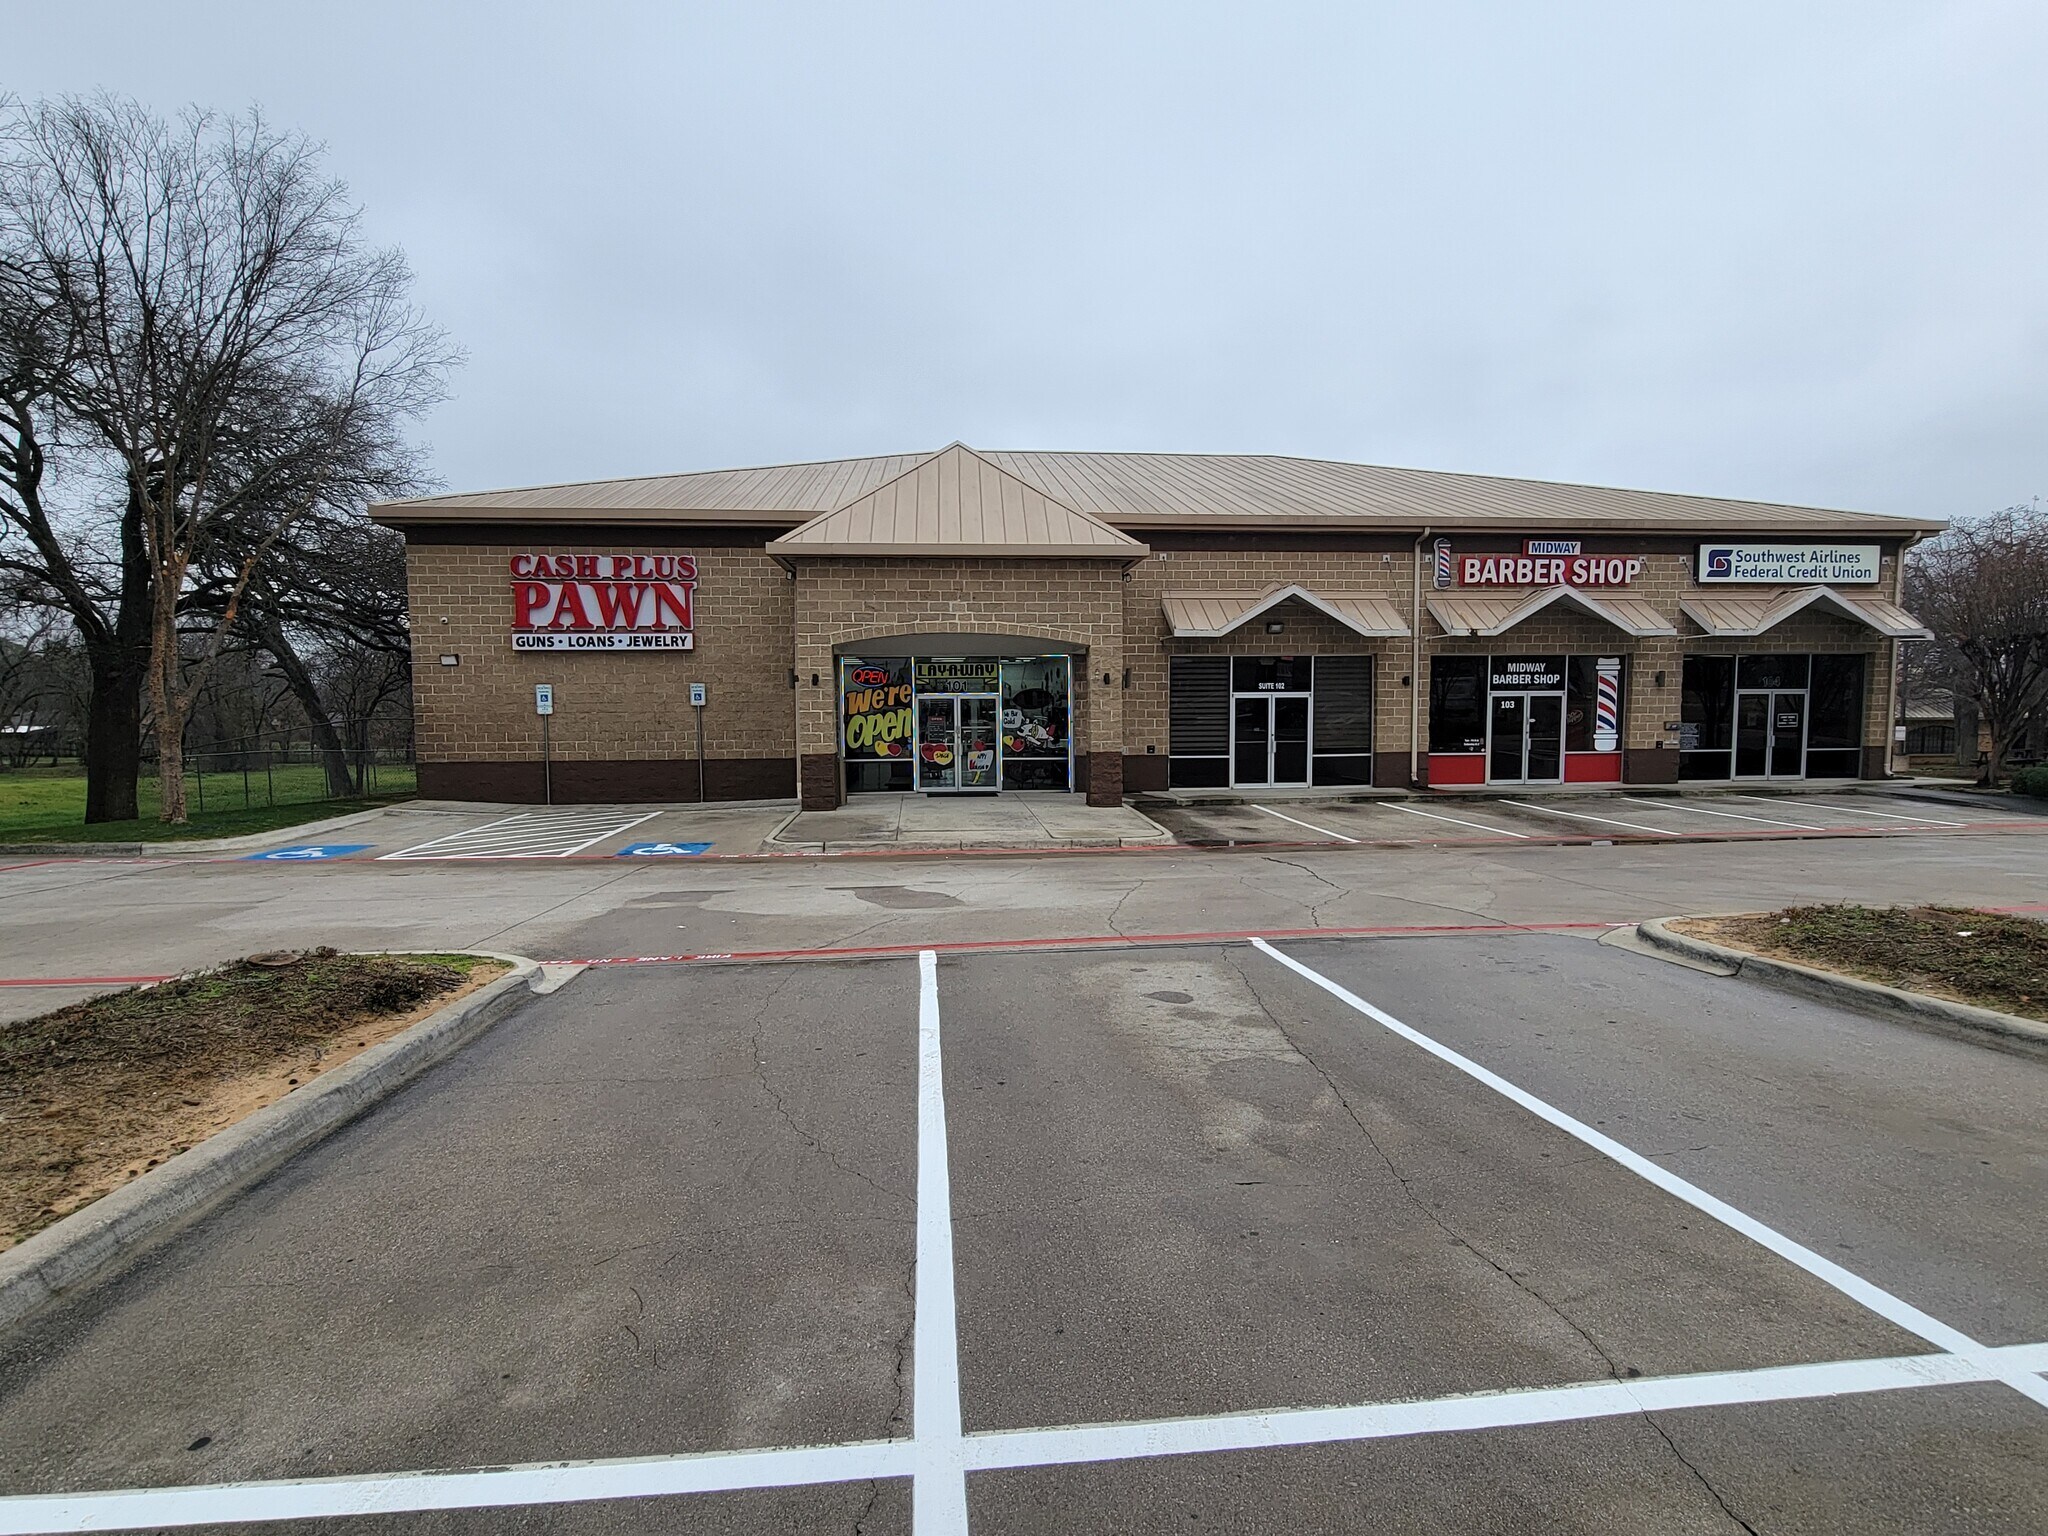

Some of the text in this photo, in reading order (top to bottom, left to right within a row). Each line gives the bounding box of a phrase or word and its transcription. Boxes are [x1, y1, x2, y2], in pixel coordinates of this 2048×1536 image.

[1531, 542, 1578, 555] MIDWAY
[1736, 550, 1861, 563] Southwest Airlines
[510, 555, 697, 580] CASH PLUS
[1464, 559, 1640, 584] BARBER SHOP
[1734, 565, 1872, 579] Federal Credit Union
[510, 581, 697, 631] PAWN
[516, 635, 688, 648] GUNS LOANS JEWELRY
[1507, 662, 1546, 673] MIDWAY
[852, 669, 889, 684] OPEN
[1493, 674, 1560, 685] BARBER SHOP
[946, 680, 968, 692] 101
[1258, 682, 1285, 690] SUITE 102
[846, 684, 912, 715] We're
[1500, 701, 1515, 709] 103
